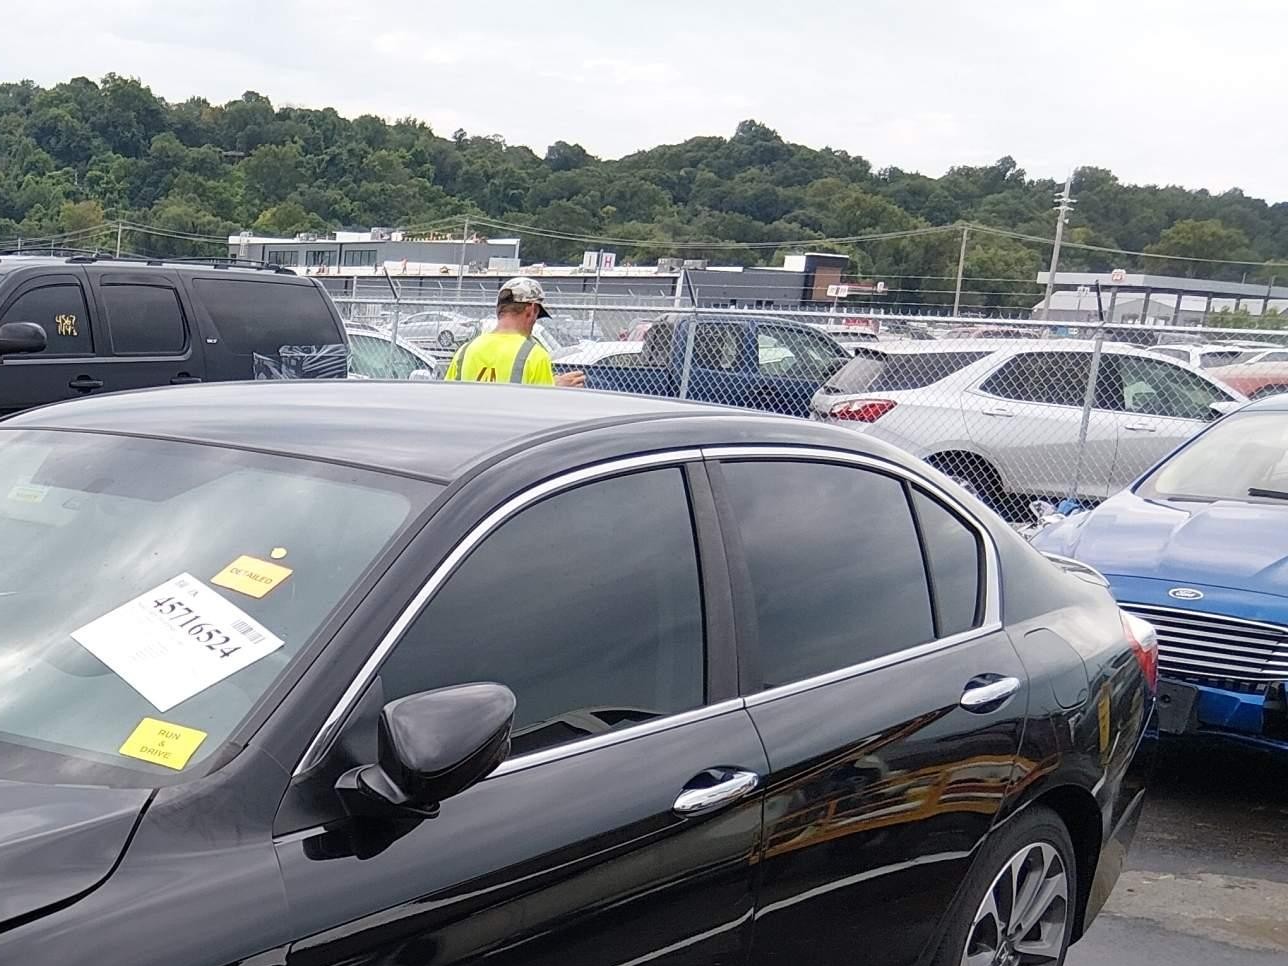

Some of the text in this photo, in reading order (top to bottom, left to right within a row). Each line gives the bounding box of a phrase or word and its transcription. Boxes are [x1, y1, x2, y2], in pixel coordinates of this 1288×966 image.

[230, 567, 273, 585] DETAILED
[153, 597, 242, 659] 45716524
[157, 729, 181, 741] RUN
[139, 745, 173, 760] DRIVE
